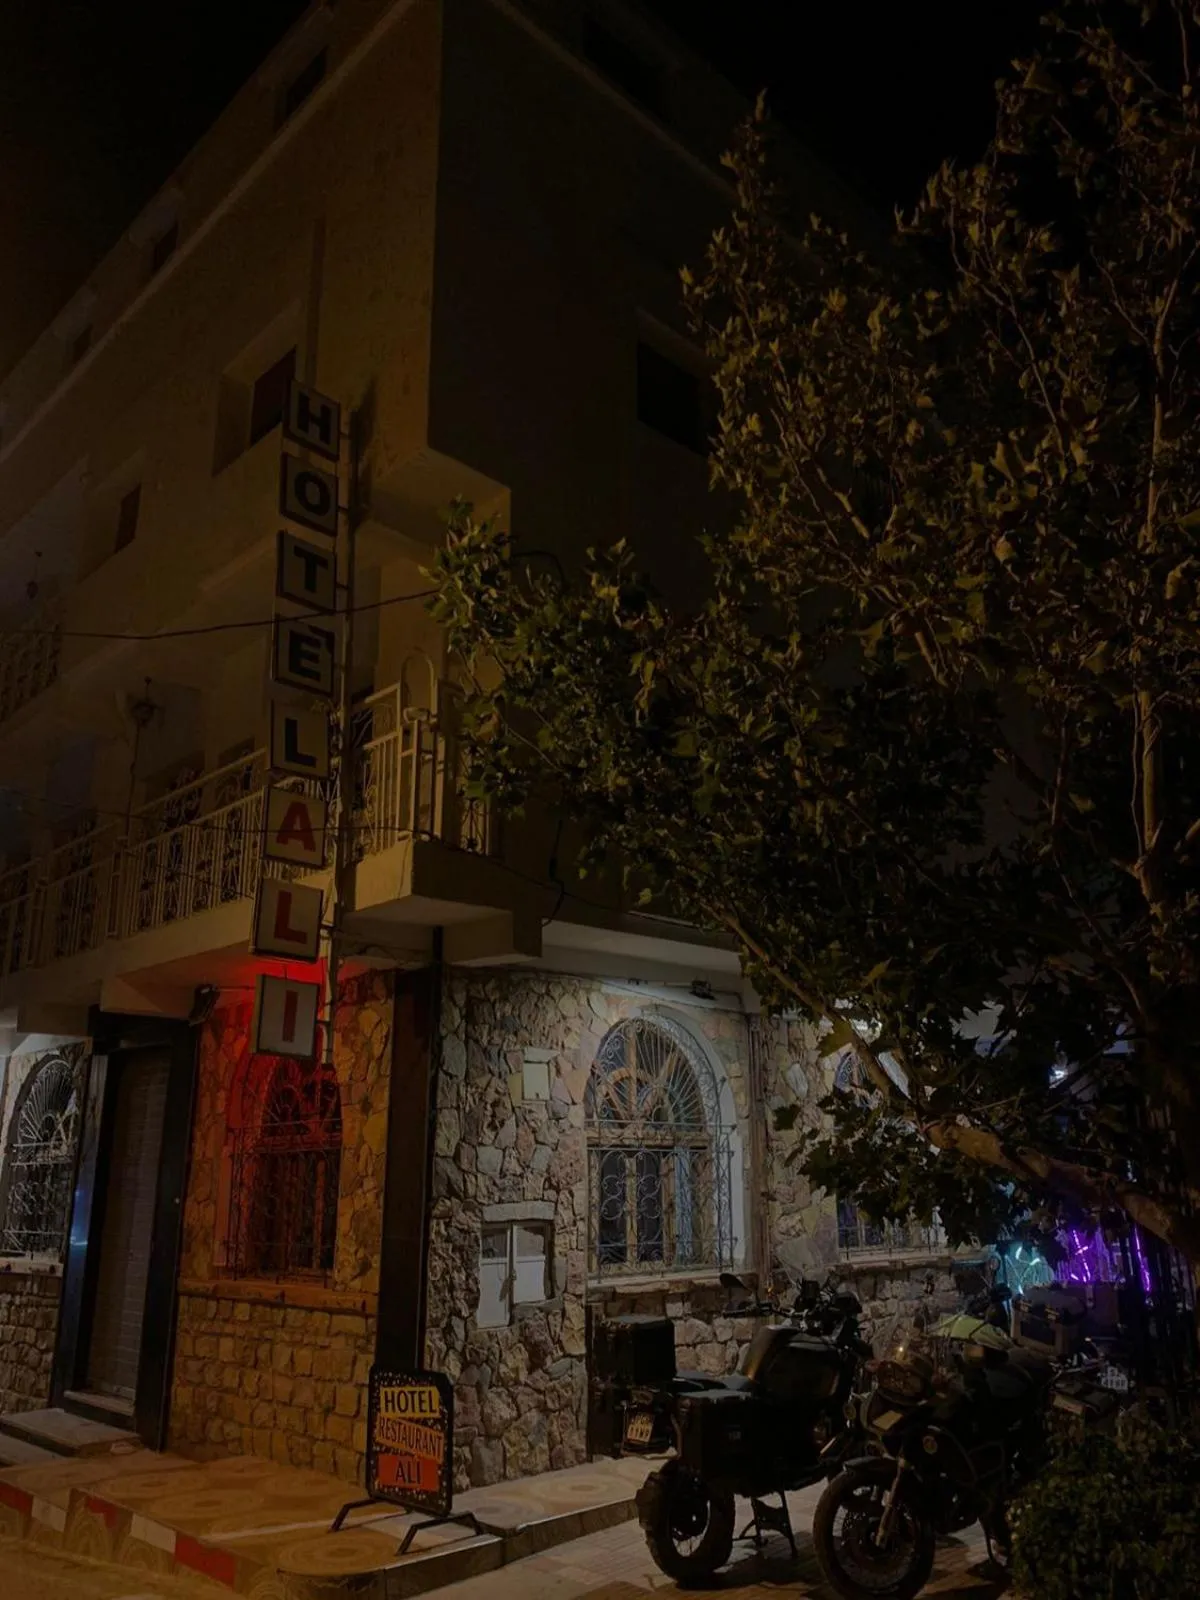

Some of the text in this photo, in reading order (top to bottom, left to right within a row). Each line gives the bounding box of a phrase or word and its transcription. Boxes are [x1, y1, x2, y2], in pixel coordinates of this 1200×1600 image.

[273, 388, 333, 1044] HOTEL ALI
[384, 1389, 437, 1414] HOTEL
[379, 1416, 443, 1459] RESTAURANT
[395, 1460, 421, 1485] ALI
